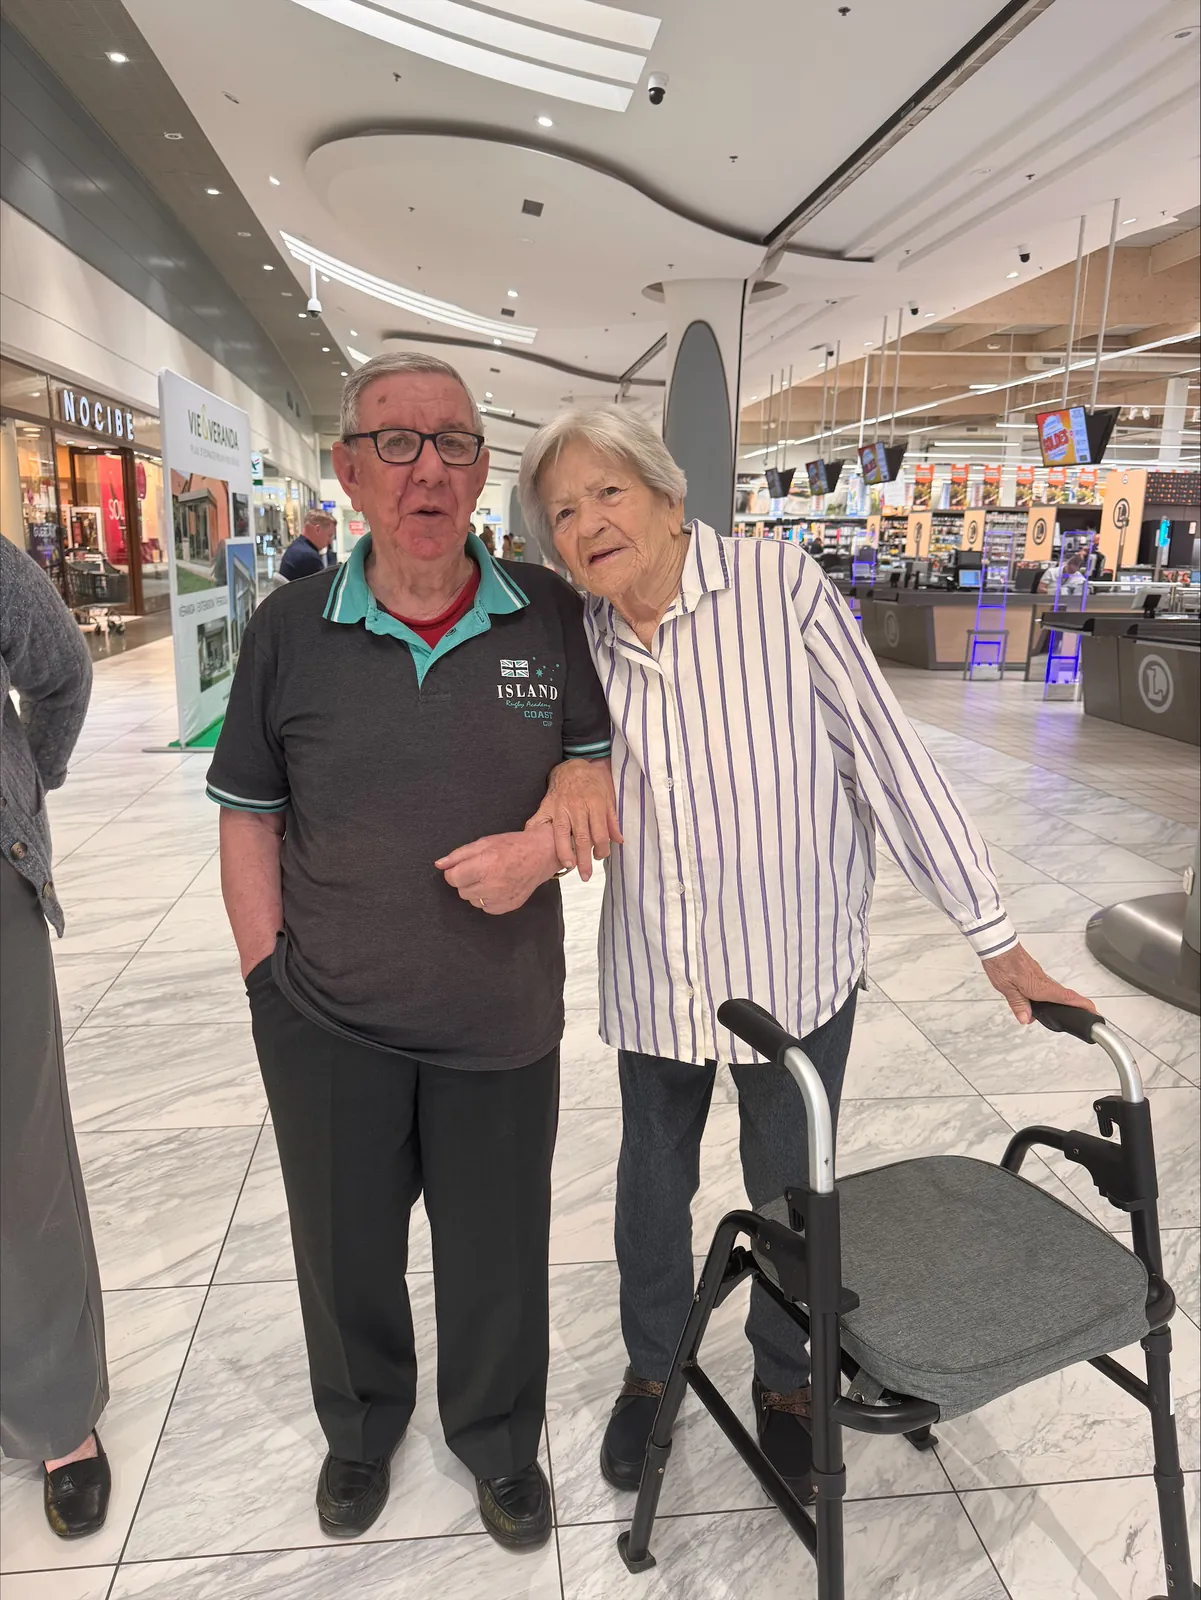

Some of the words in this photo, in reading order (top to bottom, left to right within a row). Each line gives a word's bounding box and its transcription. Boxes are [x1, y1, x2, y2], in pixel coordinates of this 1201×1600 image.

[497, 684, 558, 700] ISLAND
[505, 700, 525, 709] Rugby
[526, 701, 551, 710] Academy
[524, 711, 553, 719] COAST
